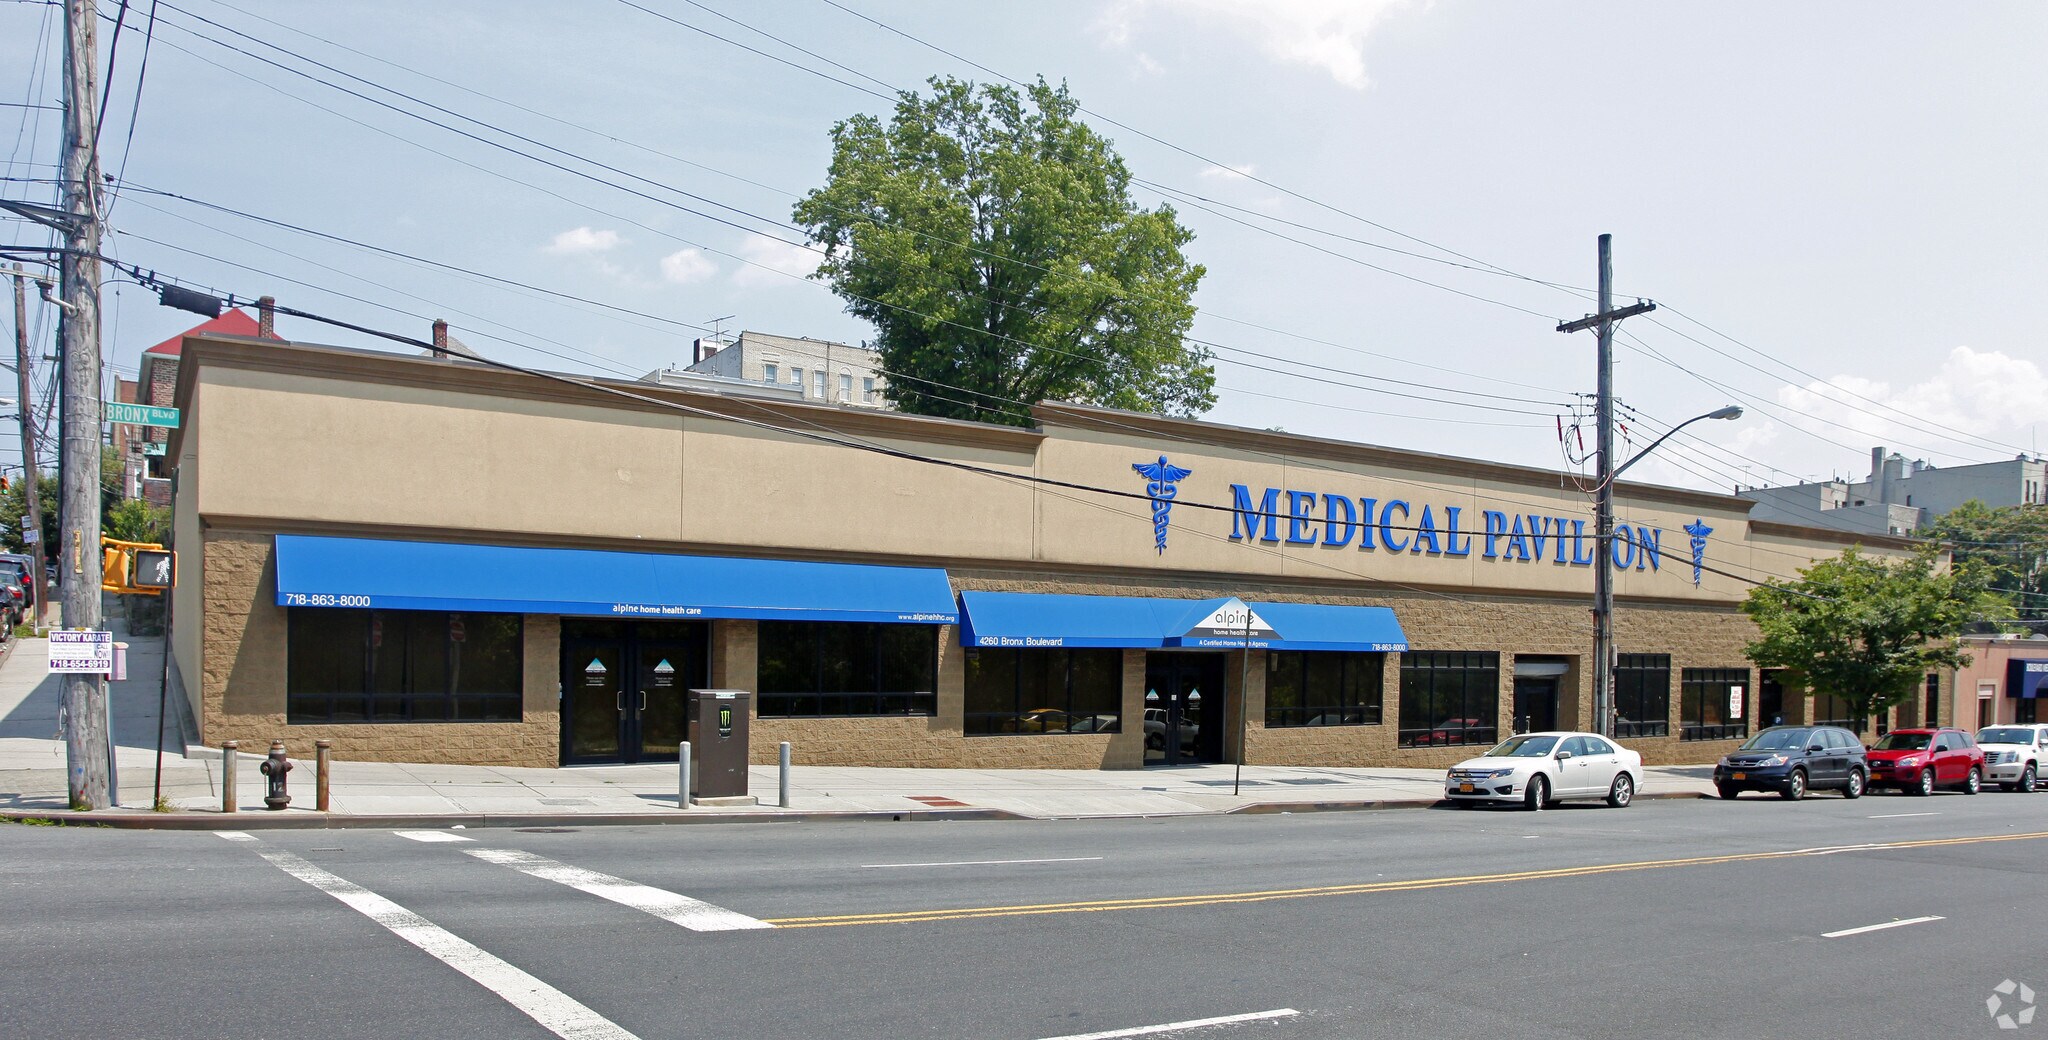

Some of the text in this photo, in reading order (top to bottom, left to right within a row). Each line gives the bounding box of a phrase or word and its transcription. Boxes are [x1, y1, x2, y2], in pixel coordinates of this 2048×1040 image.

[107, 405, 175, 423] BRONX BLVD
[1229, 484, 1662, 572] MEDICAL PAVILON
[286, 593, 371, 607] 718-863-8000
[612, 603, 639, 614] alpine
[640, 605, 661, 614] home
[662, 606, 685, 615] health
[898, 613, 955, 623] www.alpinehhc.org
[1215, 610, 1254, 627] alpine
[51, 633, 110, 642] VICTORY KARATE
[980, 637, 1063, 647] 4260 Bronx Boulevard
[1371, 643, 1406, 651] 718-863-8000
[52, 660, 109, 668] 718-654-6919
